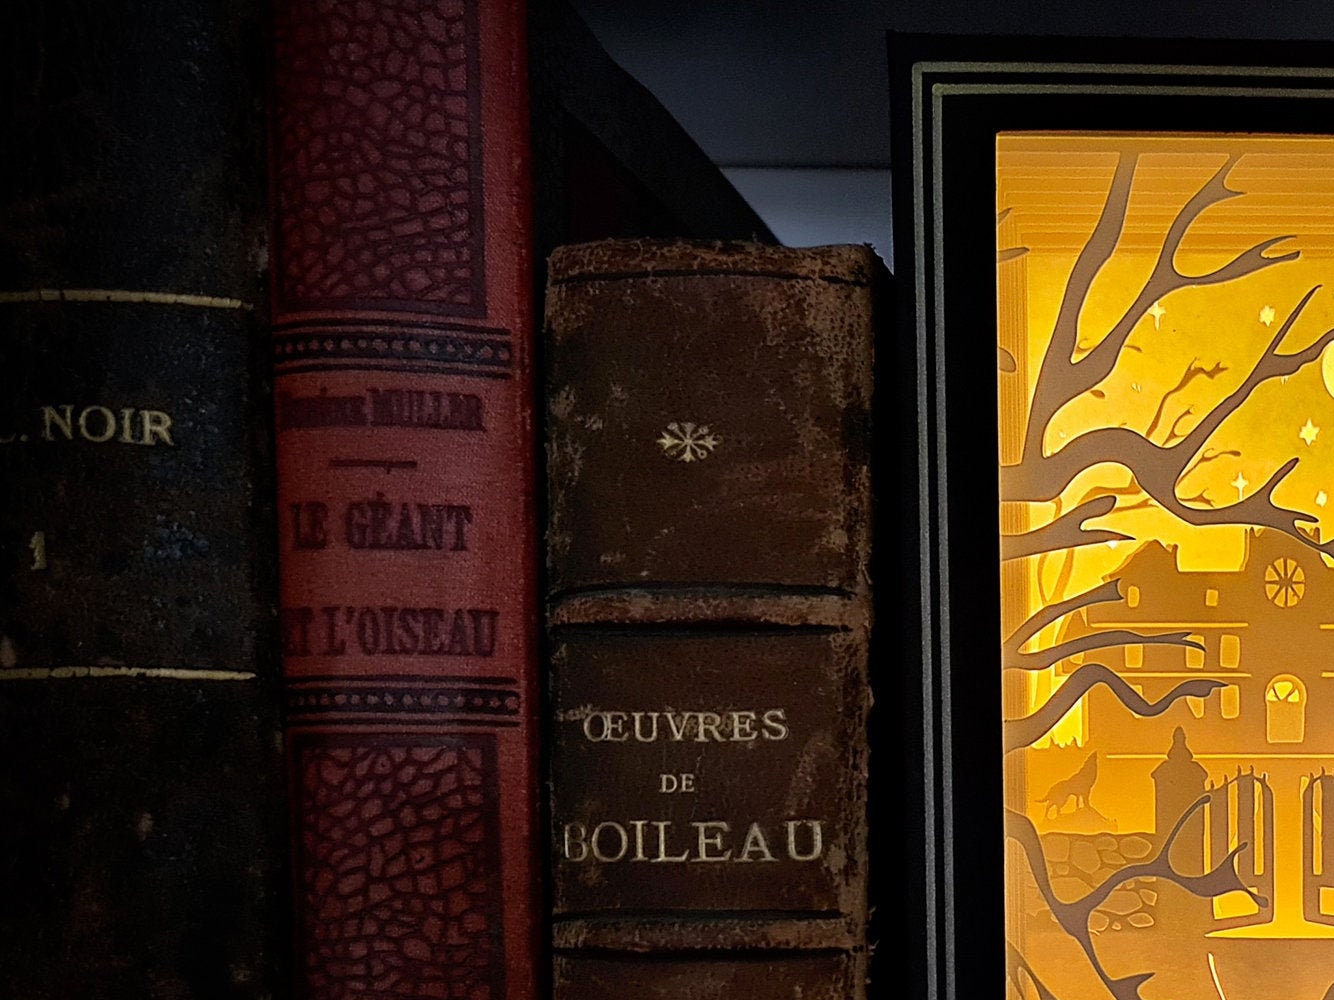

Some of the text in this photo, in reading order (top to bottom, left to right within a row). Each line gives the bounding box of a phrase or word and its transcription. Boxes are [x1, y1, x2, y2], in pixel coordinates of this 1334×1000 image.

[40, 404, 175, 447] NOIR
[290, 501, 328, 550] LE
[28, 530, 48, 570] 1
[320, 606, 499, 657] L'OISEAU
[583, 708, 790, 742] ŒUVRES
[659, 773, 695, 793] DE
[563, 818, 827, 863] BOILEAU
